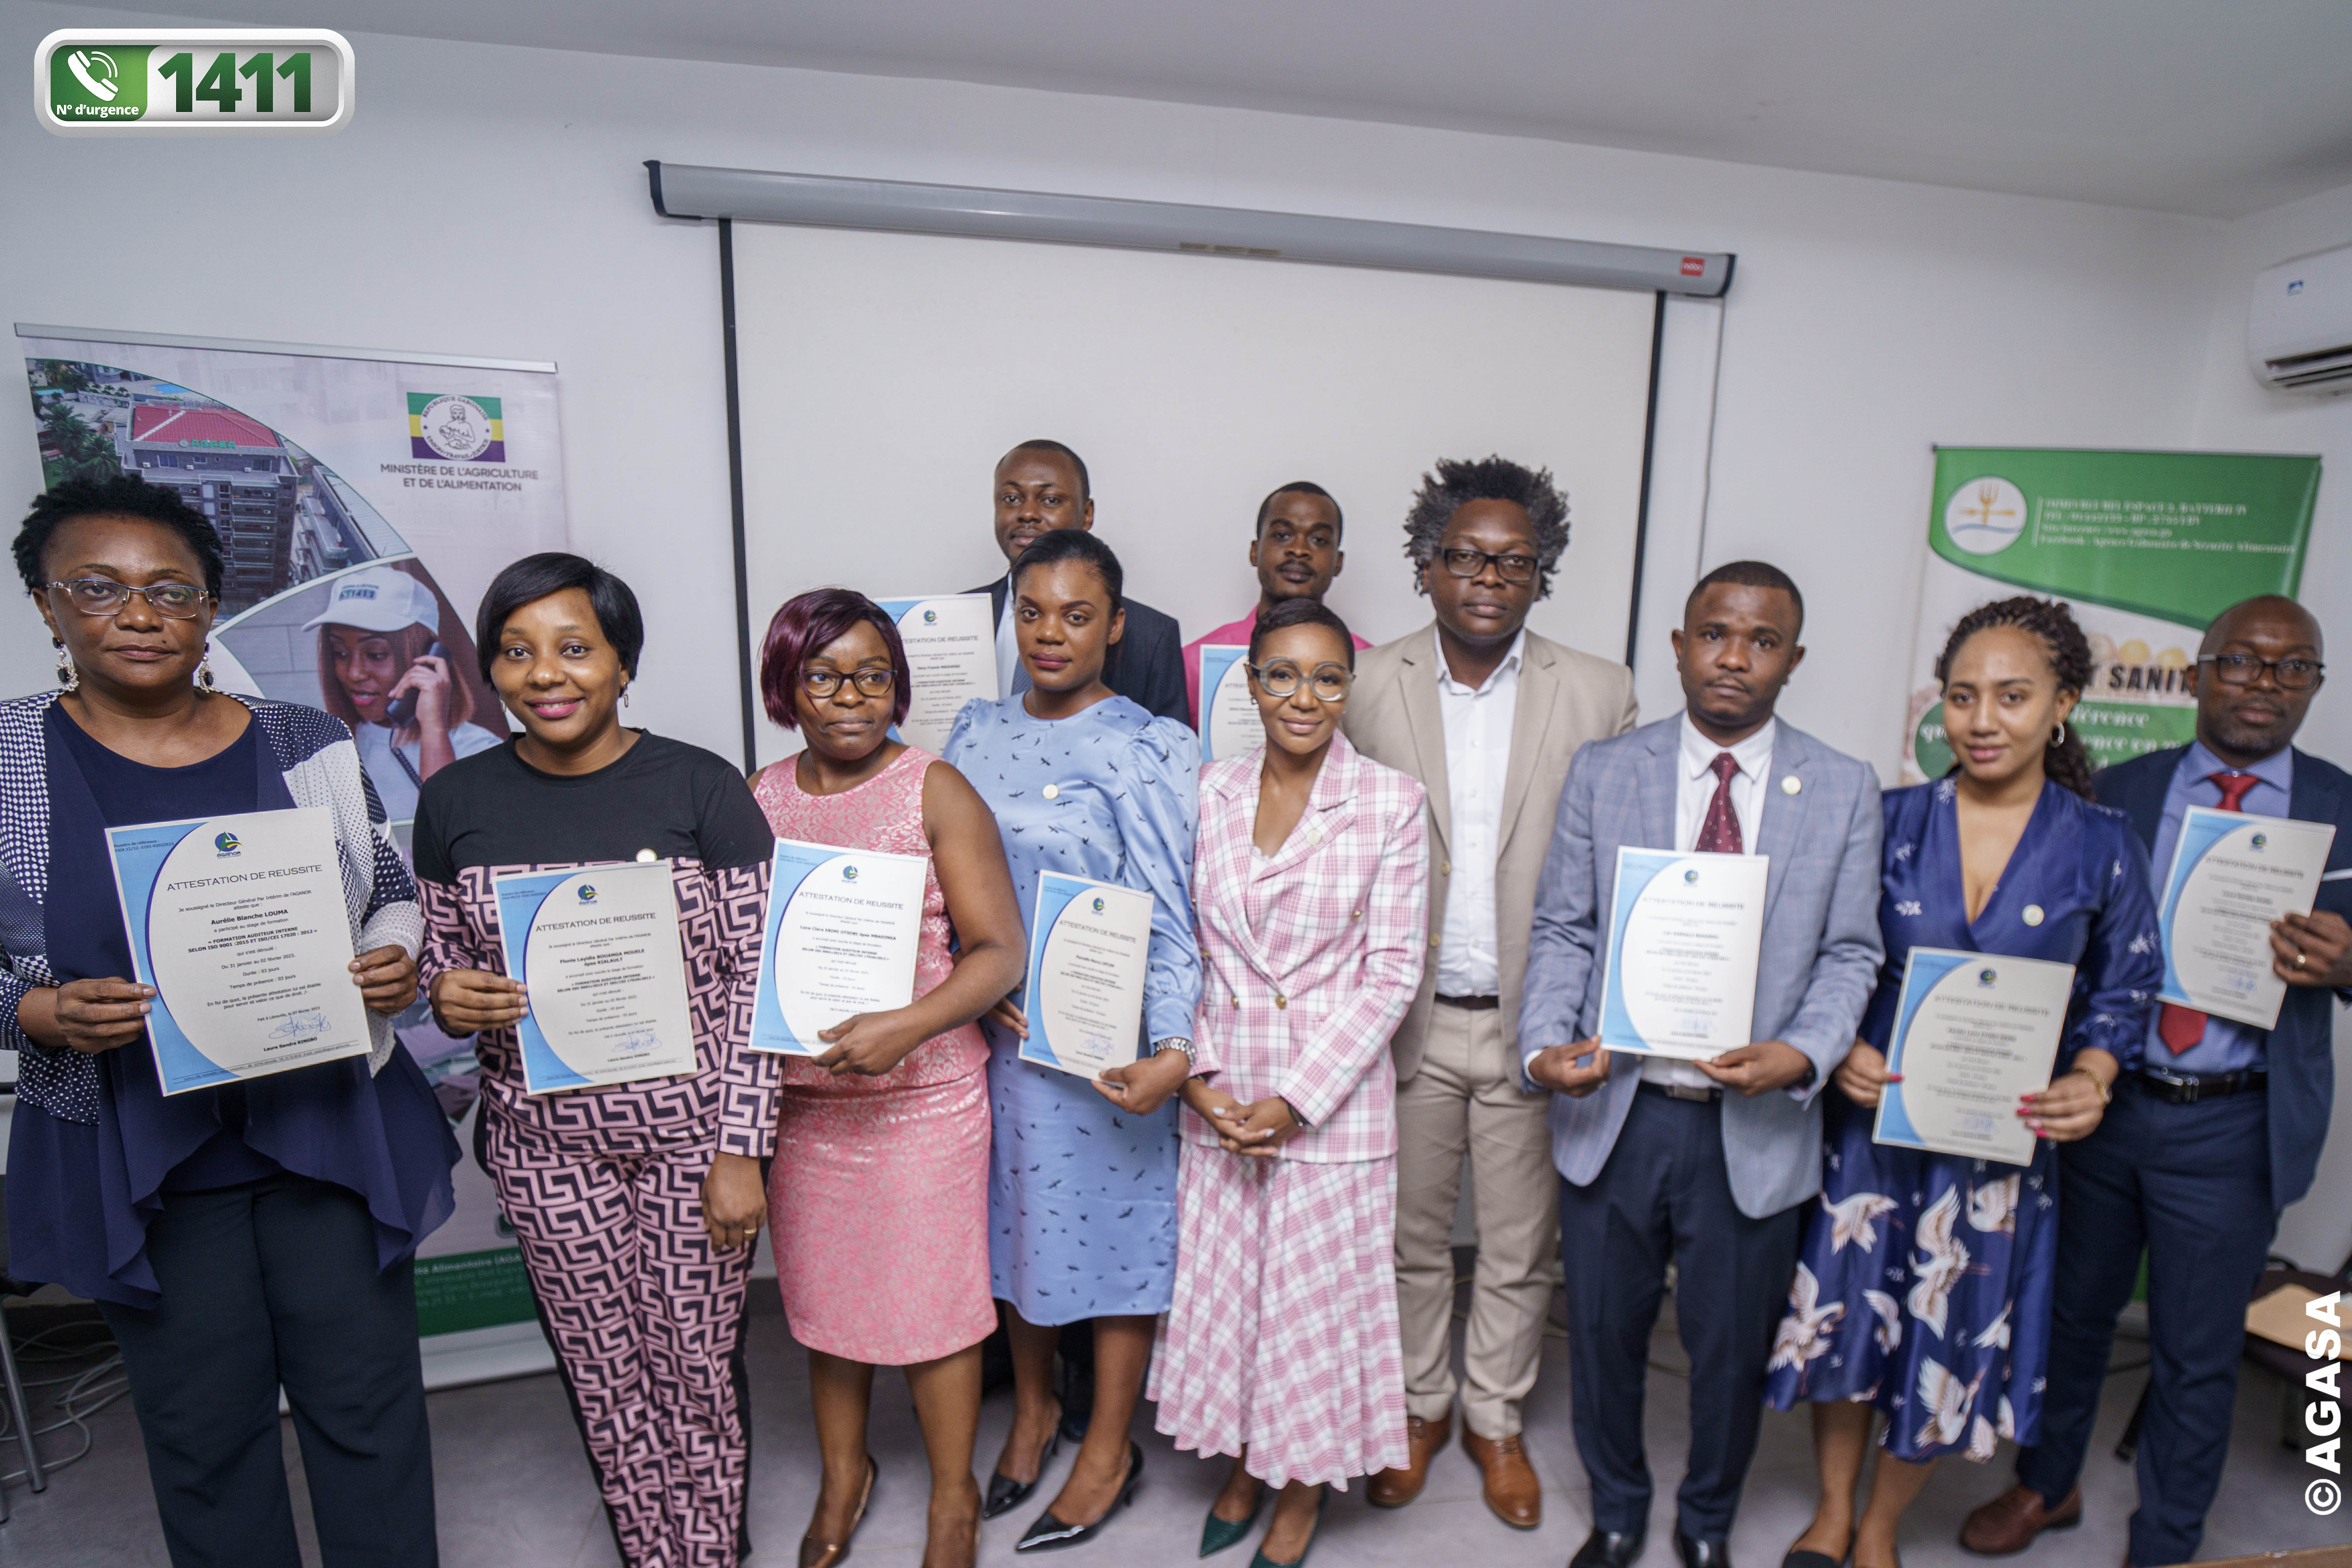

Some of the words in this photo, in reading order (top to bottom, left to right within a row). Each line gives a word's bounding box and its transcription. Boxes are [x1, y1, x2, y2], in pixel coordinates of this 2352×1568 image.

[381, 463, 437, 475] MINISTÈRE
[440, 466, 454, 476] DE
[457, 467, 539, 479] L'AGRICULTURE
[403, 477, 416, 487] ET
[419, 478, 434, 488] DE
[437, 479, 522, 491] L'ALIMENTATION
[2109, 665, 2189, 693] SANIT
[167, 874, 247, 891] ATTESTATION
[250, 872, 266, 880] DE
[268, 864, 322, 877] REUSSITE
[799, 891, 852, 903] ATTESTATION
[866, 900, 903, 909] REUSSITE
[536, 919, 597, 932] ATTESTATION
[613, 913, 656, 922] REUSSITE
[213, 935, 246, 943] FORMATION
